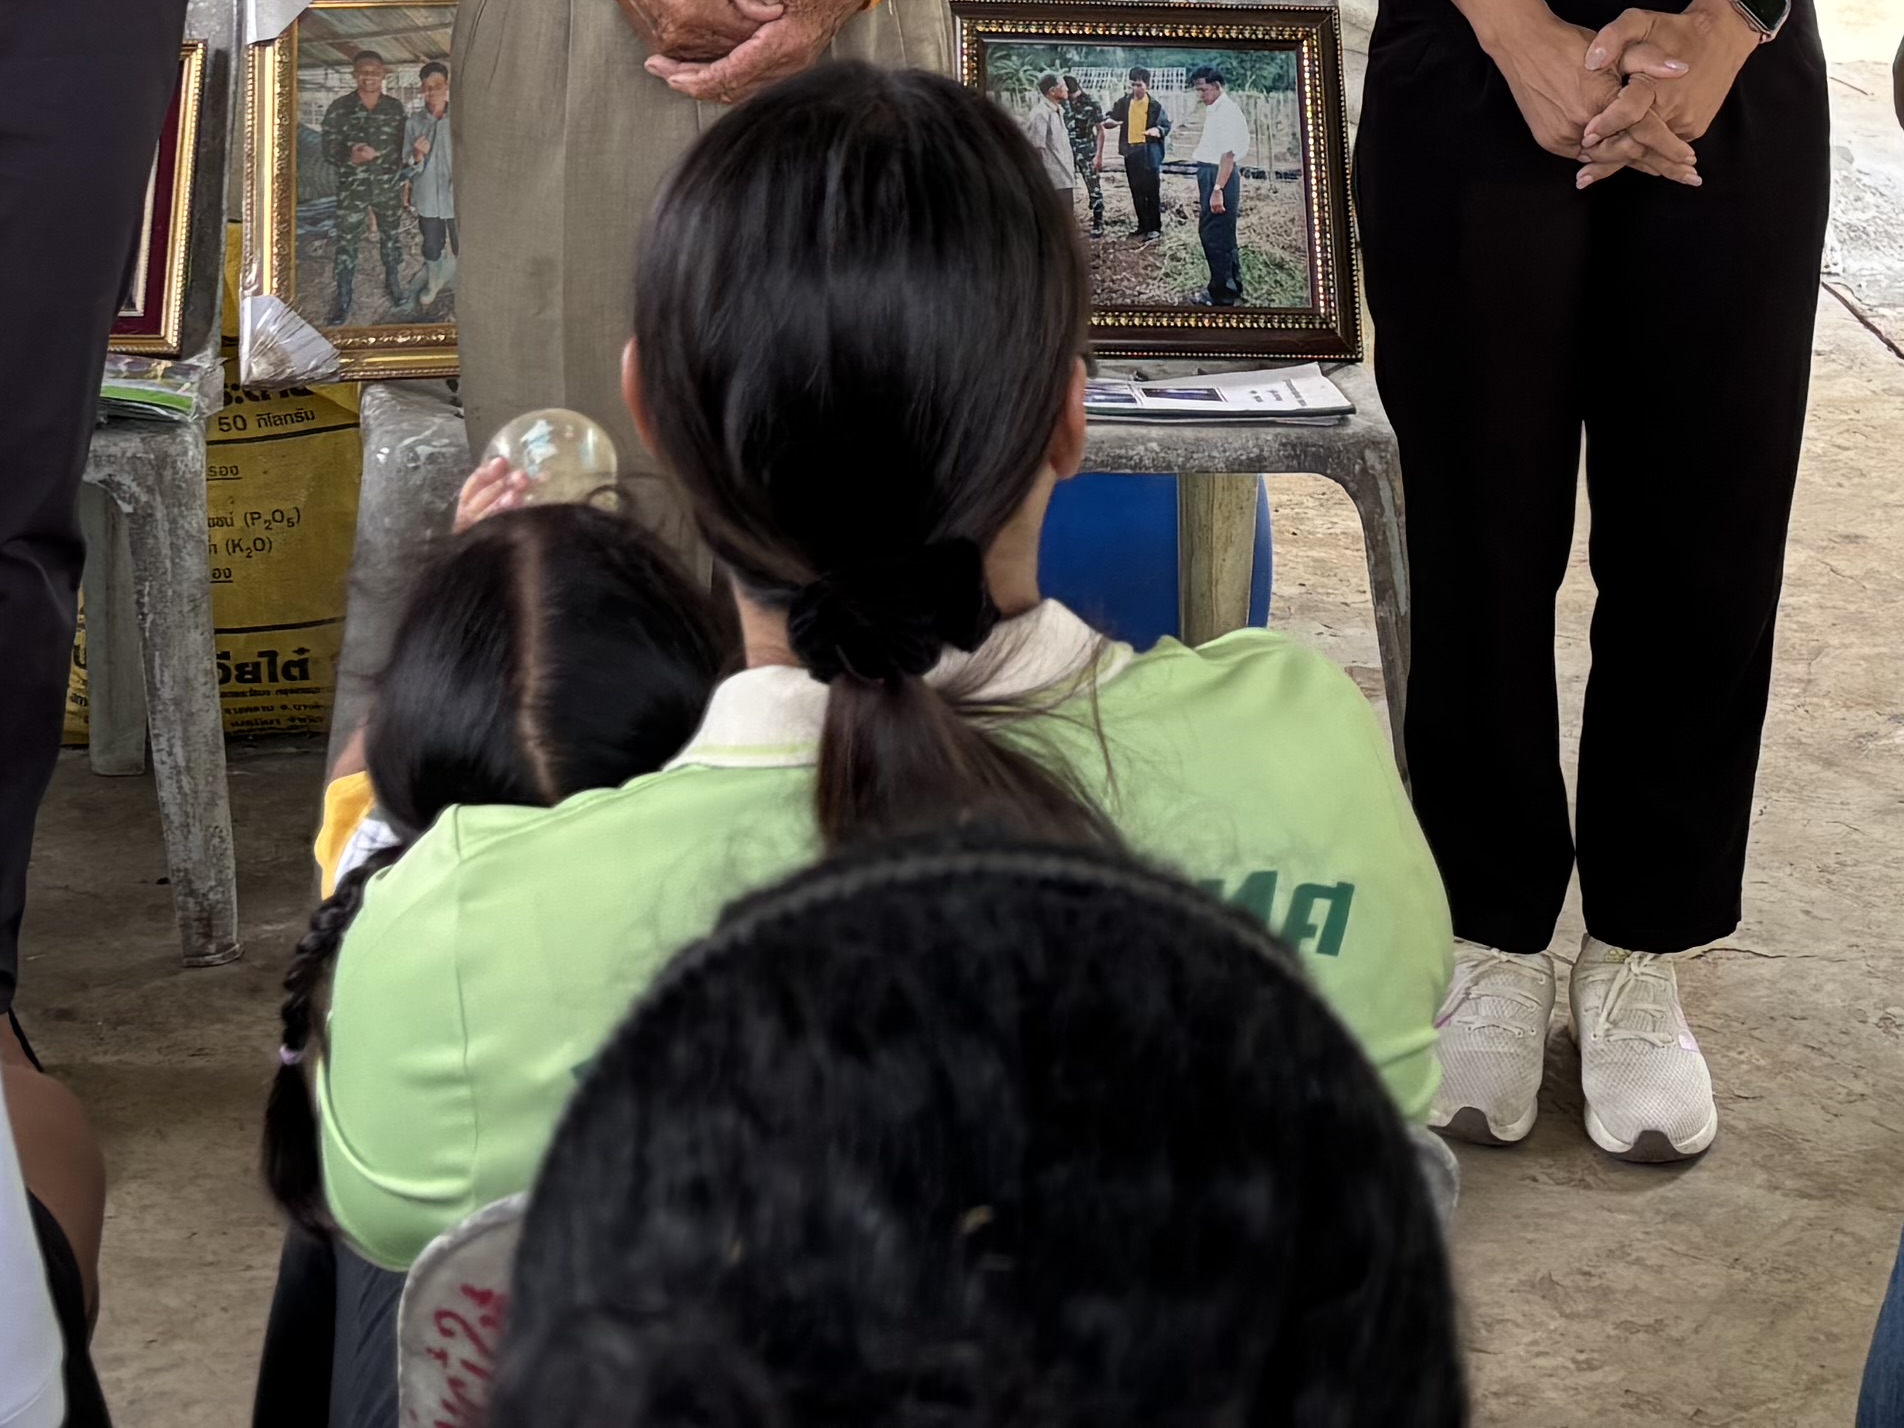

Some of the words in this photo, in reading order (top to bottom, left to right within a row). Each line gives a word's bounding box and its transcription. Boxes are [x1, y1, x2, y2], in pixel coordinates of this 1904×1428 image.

[218, 413, 247, 433] 50
[256, 407, 315, 429] กิโลกรัม
